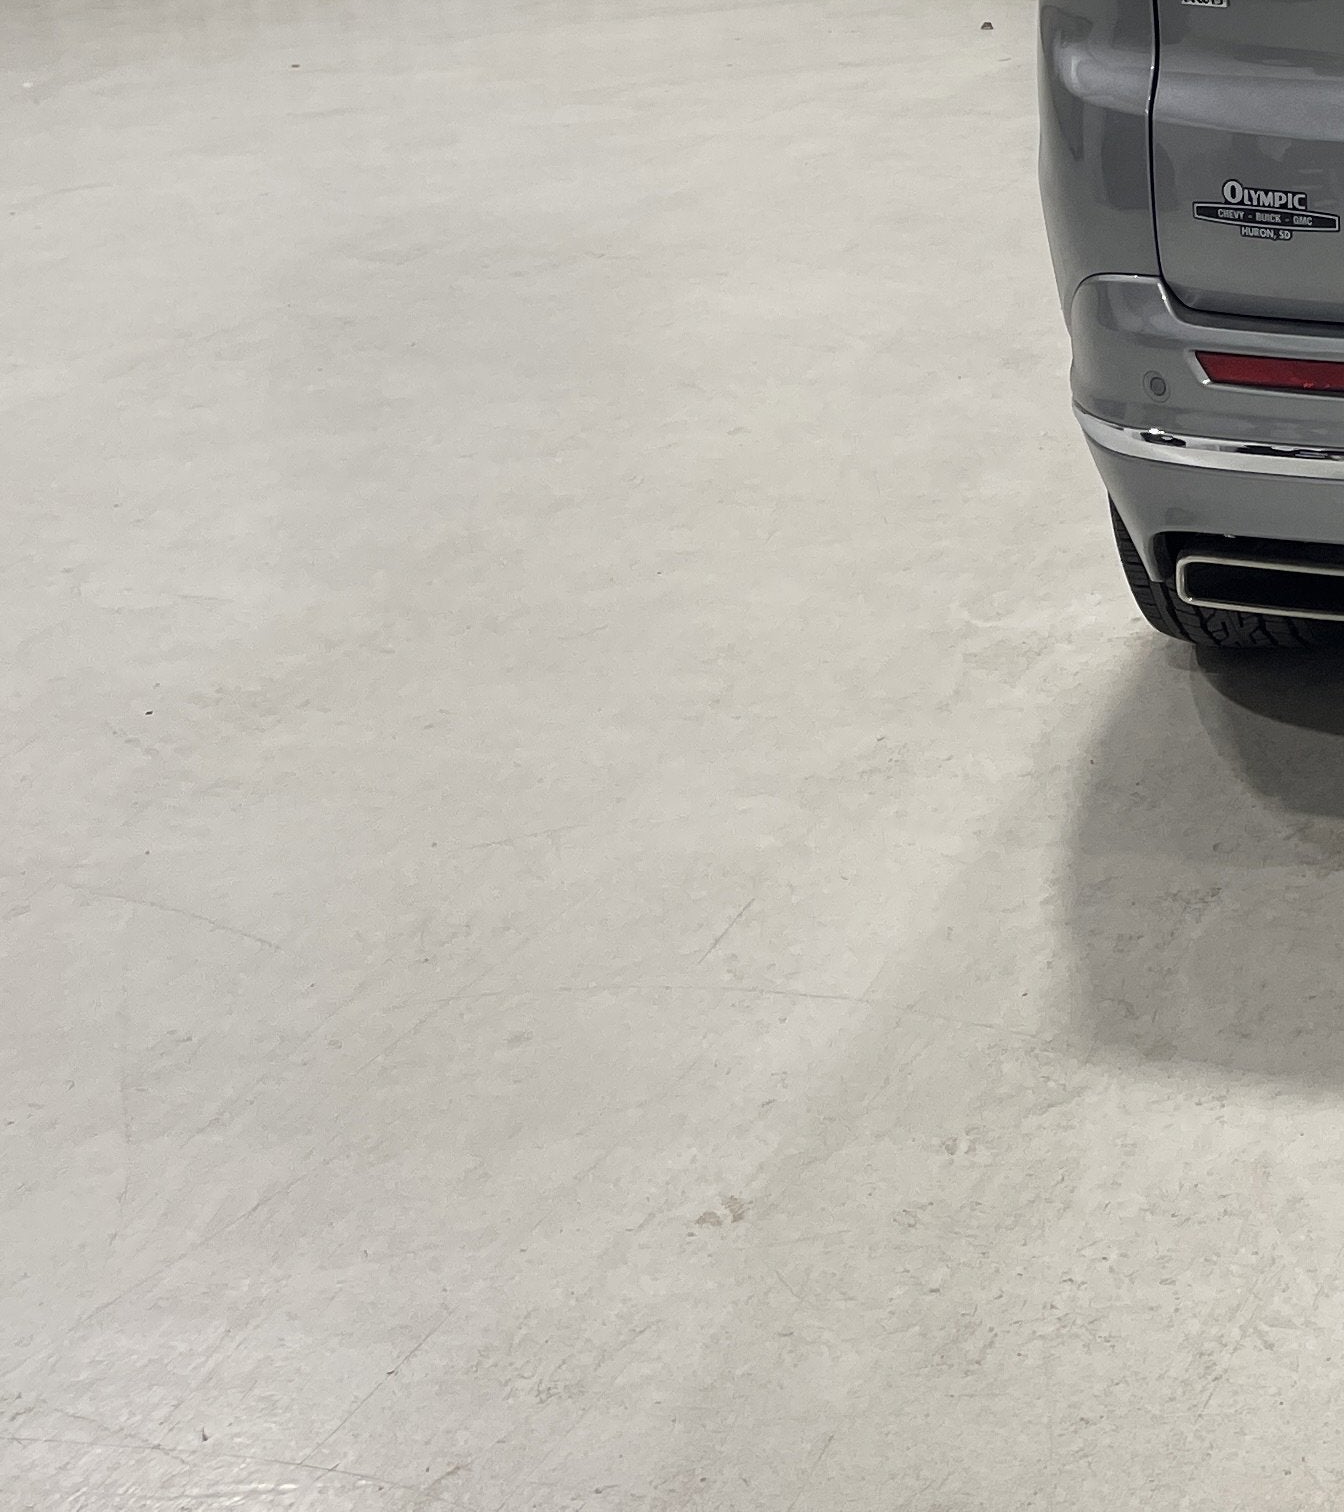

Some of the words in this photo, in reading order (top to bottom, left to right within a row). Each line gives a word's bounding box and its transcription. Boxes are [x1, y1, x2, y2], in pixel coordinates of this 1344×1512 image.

[1217, 209, 1244, 220] CHEVY
[1255, 211, 1282, 223] BUICK
[1293, 216, 1313, 226] GMC
[1279, 230, 1291, 240] SD
